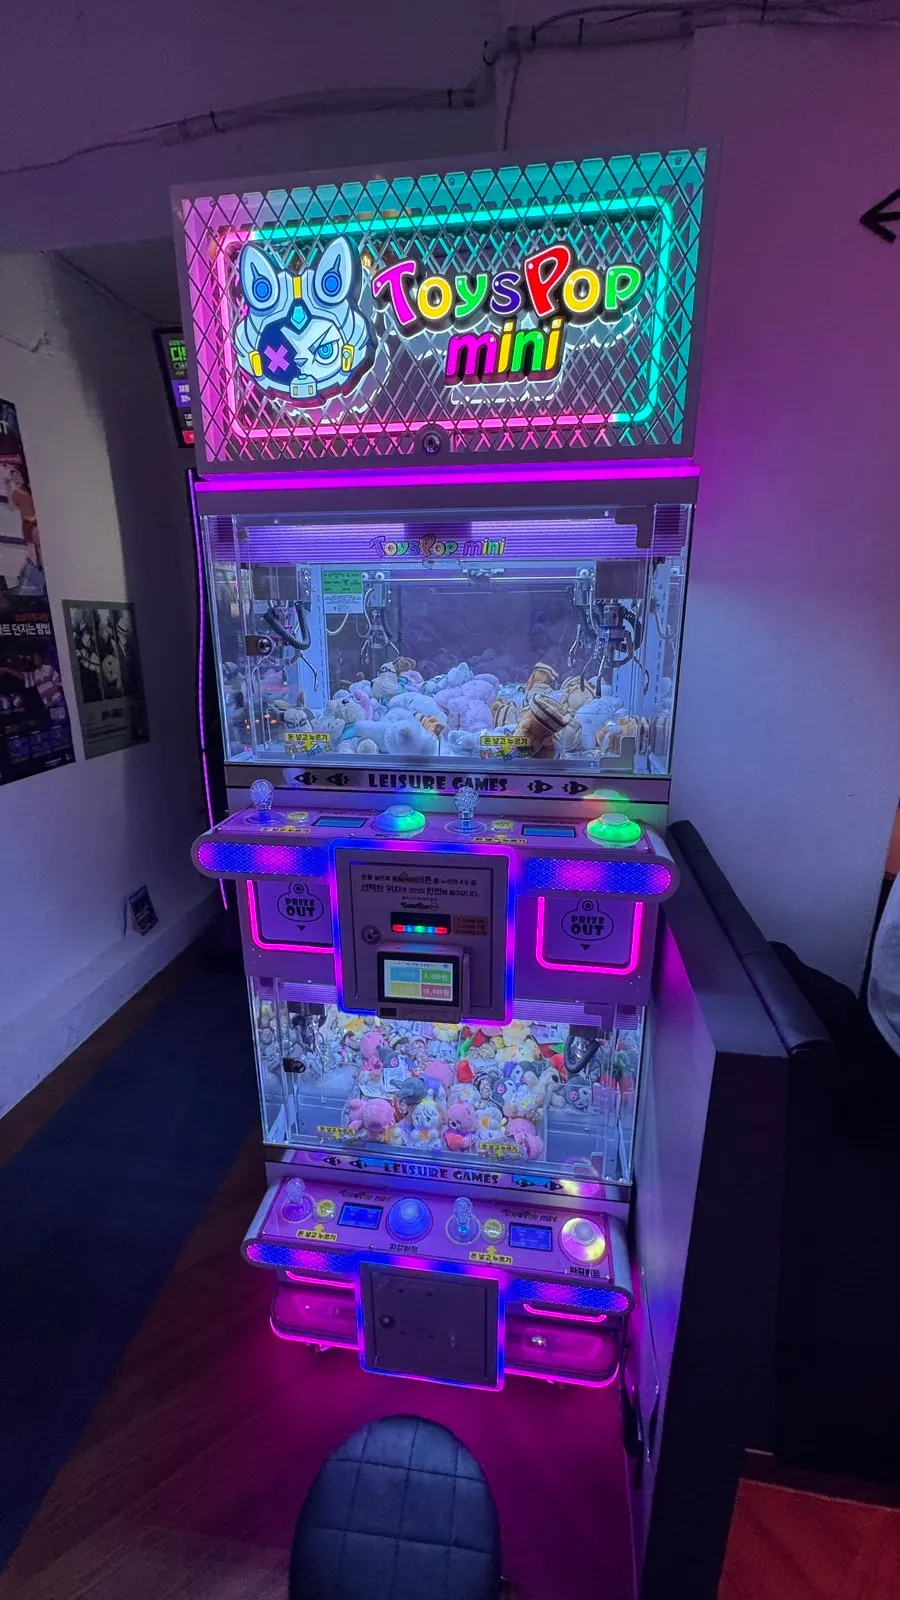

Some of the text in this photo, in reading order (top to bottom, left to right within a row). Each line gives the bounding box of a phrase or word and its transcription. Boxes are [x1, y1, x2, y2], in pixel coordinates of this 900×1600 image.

[446, 315, 566, 379] mini
[463, 536, 507, 556] mini
[368, 773, 508, 792] LEISURE GAMES
[285, 897, 315, 906] PRIZE
[286, 905, 315, 917] OUT
[571, 915, 604, 924] PRIZE
[570, 923, 604, 936] OUT
[383, 1161, 499, 1184] LEISURE GAMES
